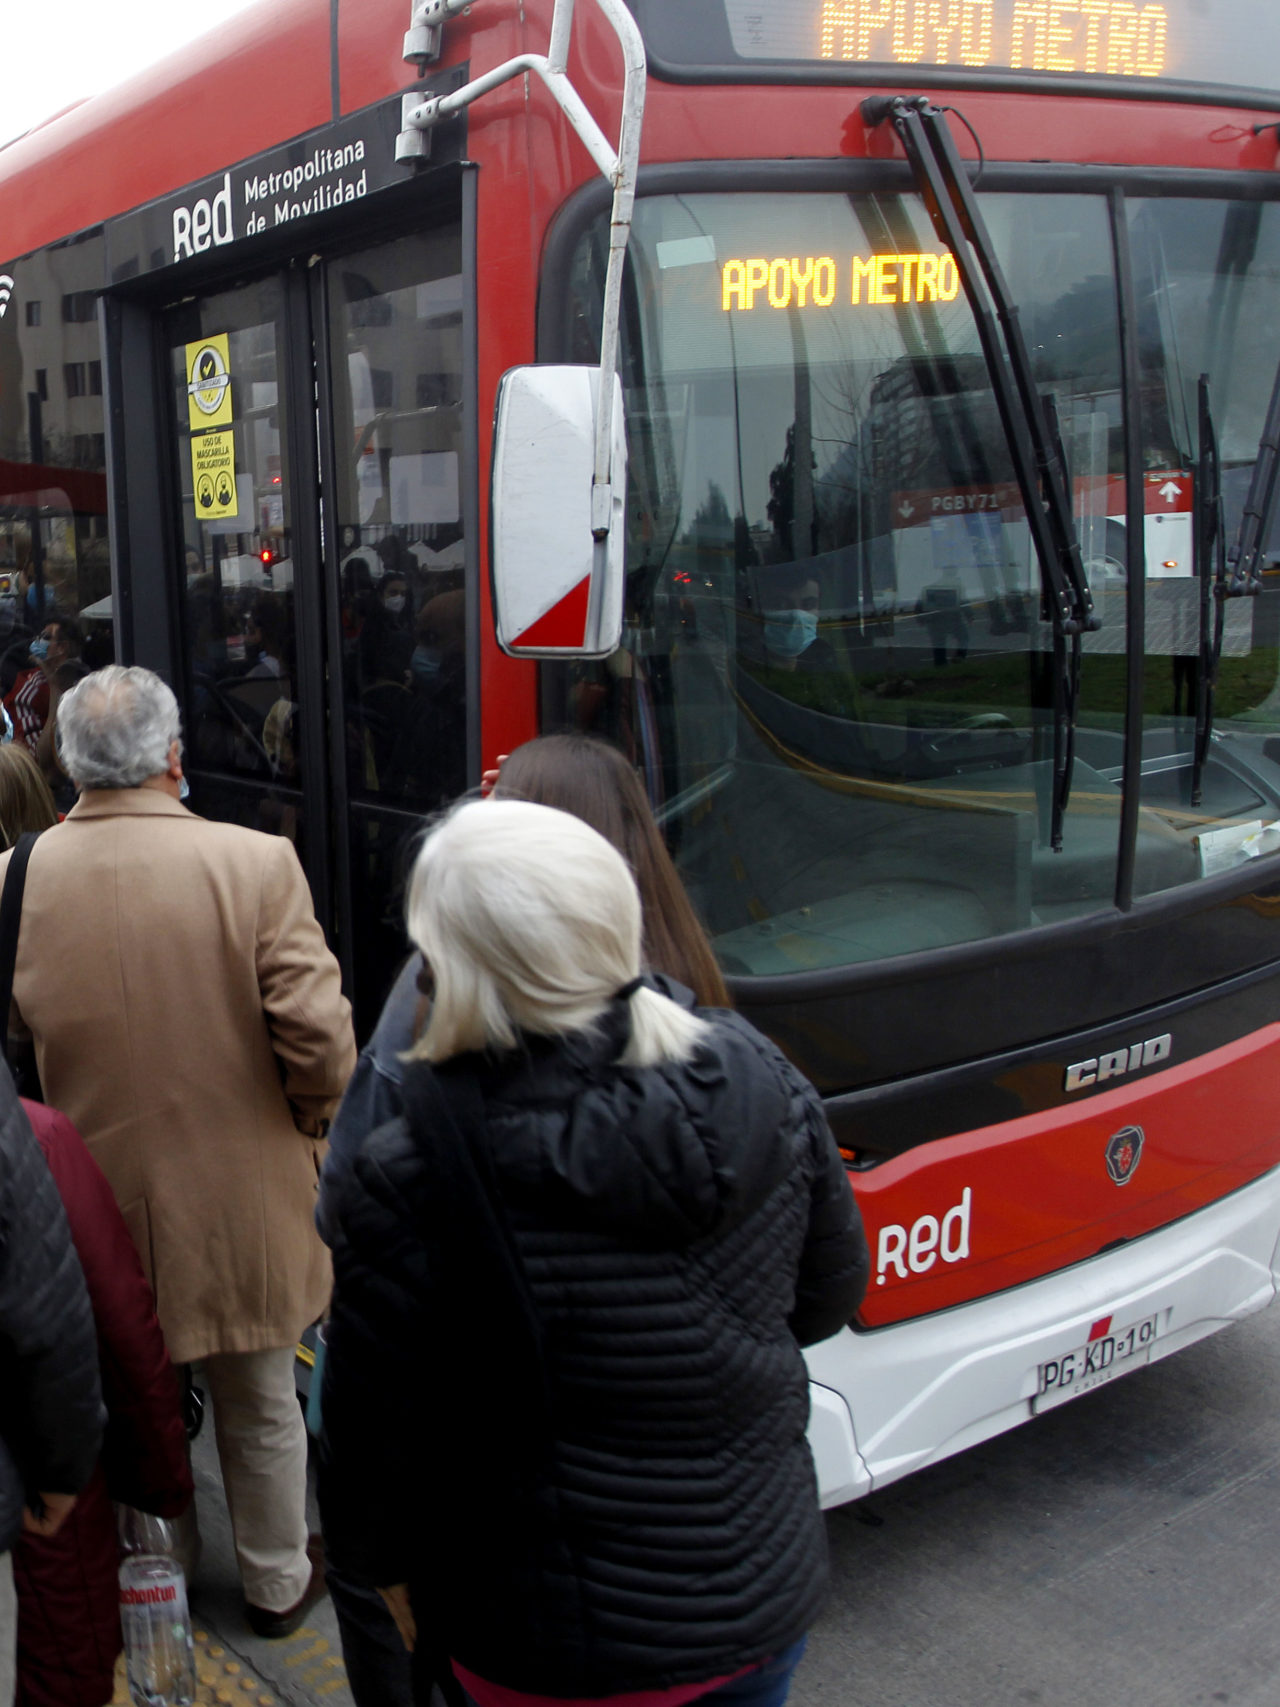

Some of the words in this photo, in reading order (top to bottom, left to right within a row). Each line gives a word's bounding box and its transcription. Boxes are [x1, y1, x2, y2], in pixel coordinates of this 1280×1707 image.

[821, 0, 993, 68] APOYO
[1010, 0, 1168, 77] METRO
[245, 139, 365, 204] Metropolitana
[247, 212, 267, 237] de
[274, 170, 367, 226] Movilidad
[722, 257, 836, 311] APOYO
[851, 253, 960, 305] METRO
[197, 446, 229, 458] MASCARILLA
[197, 457, 231, 470] OBLIGATORIO
[203, 437, 214, 447] USO
[215, 435, 223, 445] DE
[931, 494, 999, 511] PGBY71
[1065, 1034, 1171, 1091] CAIO
